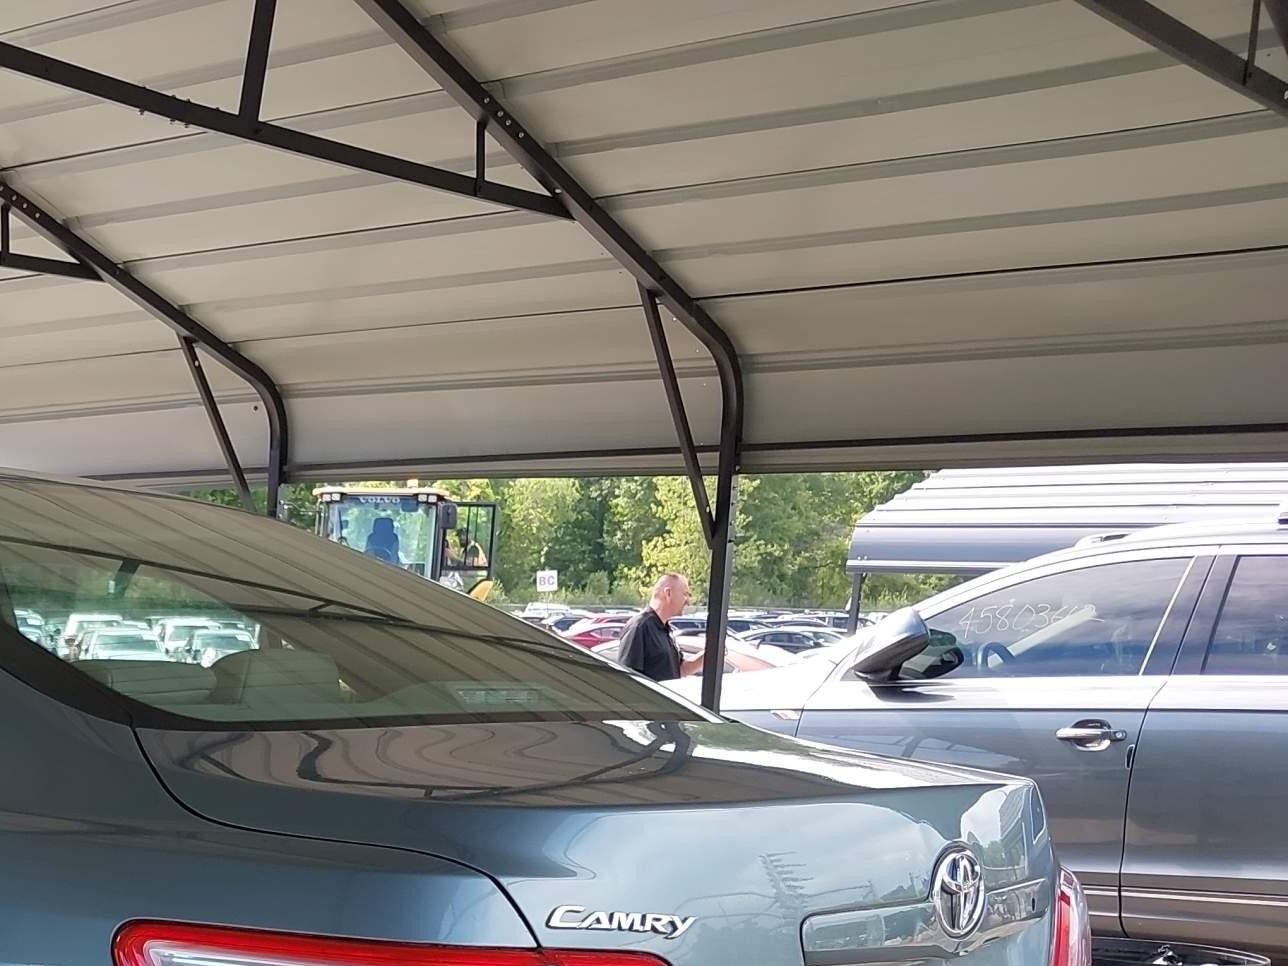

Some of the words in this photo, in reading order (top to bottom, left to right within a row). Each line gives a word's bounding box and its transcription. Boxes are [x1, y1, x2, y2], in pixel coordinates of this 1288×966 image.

[358, 495, 401, 504] VOLVO
[539, 575, 555, 586] BC
[545, 904, 698, 940] CAMRY
